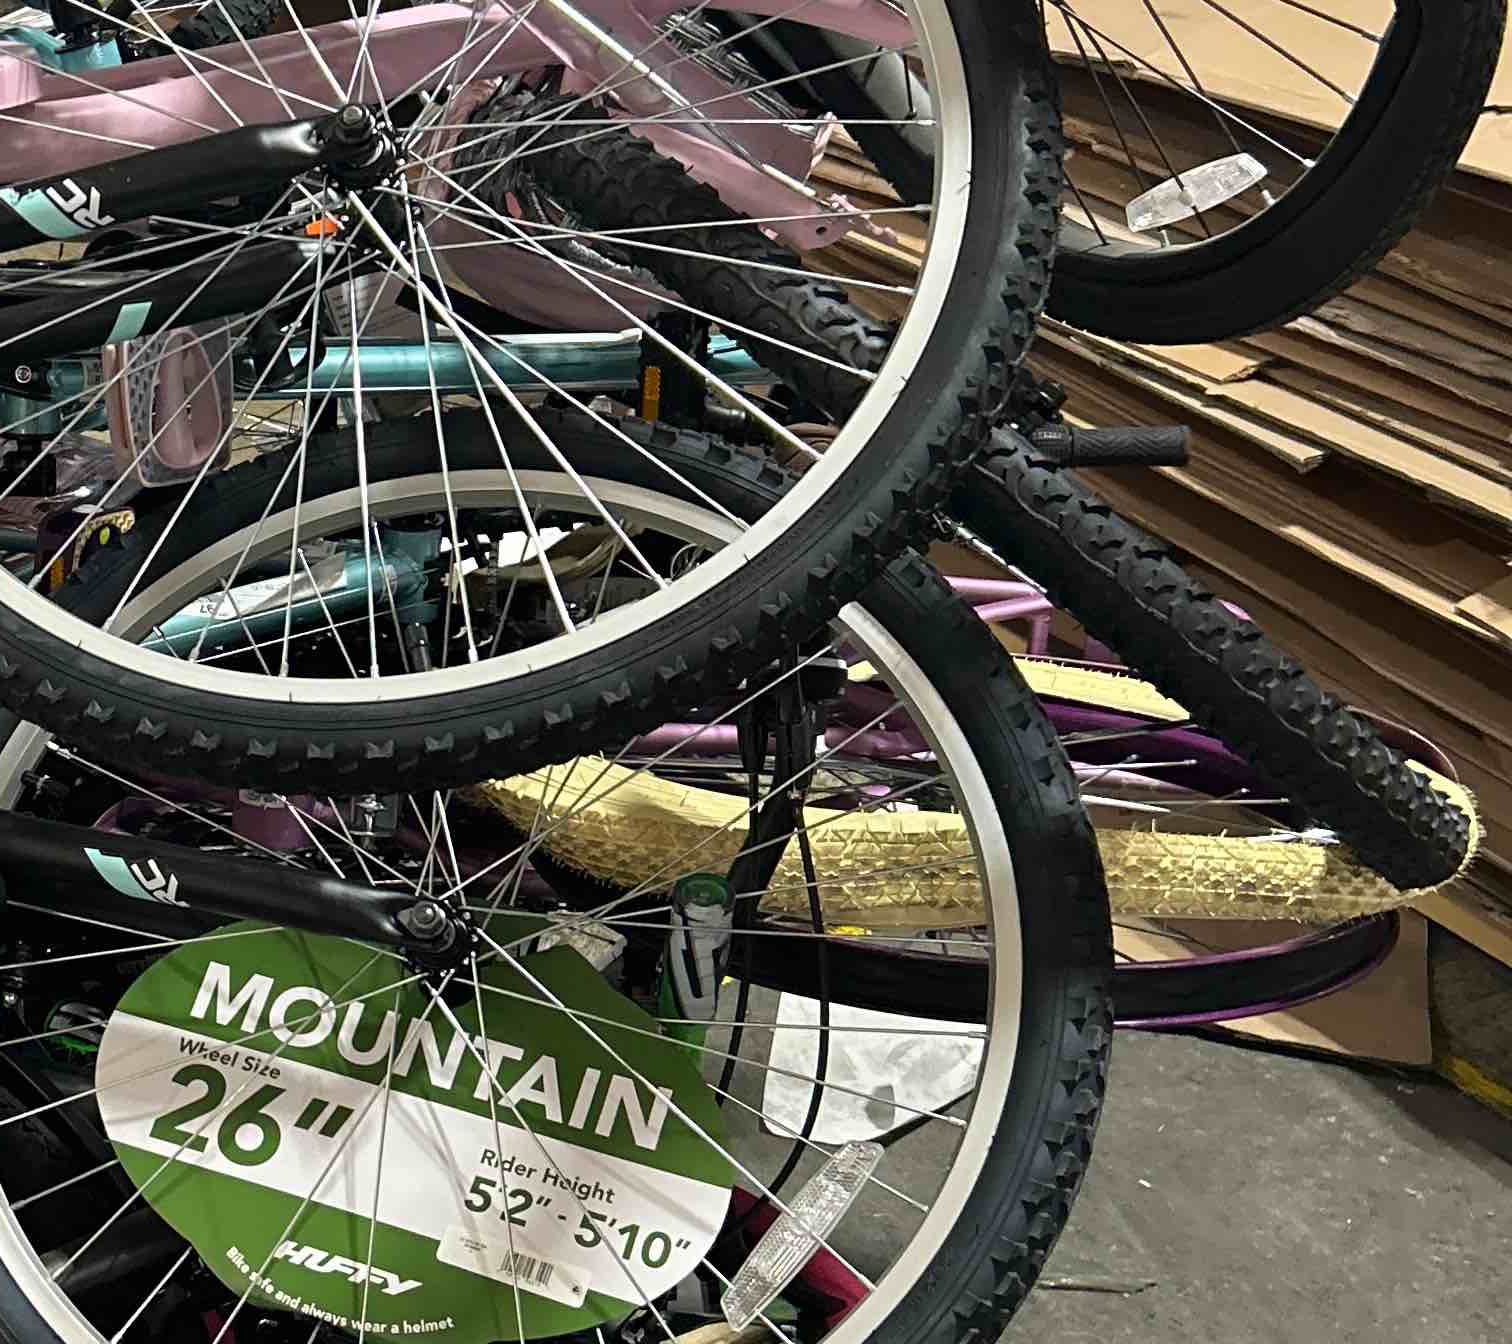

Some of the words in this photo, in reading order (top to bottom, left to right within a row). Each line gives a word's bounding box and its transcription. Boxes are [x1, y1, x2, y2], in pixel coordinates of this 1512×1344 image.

[179, 1036, 239, 1069] Wheel
[242, 1054, 282, 1080] Size
[190, 961, 673, 1152] MOUNTAIN
[149, 1064, 355, 1167] 26"
[480, 1148, 537, 1180] Rider
[542, 1169, 616, 1205] Height
[274, 1239, 423, 1296] HUFFY
[574, 1210, 691, 1268] 5'10"
[226, 1245, 250, 1275] Bike
[275, 1289, 300, 1310] and
[301, 1302, 347, 1328] always
[351, 1319, 388, 1334] wear
[391, 1323, 400, 1335] a
[403, 1316, 455, 1335] helmet
